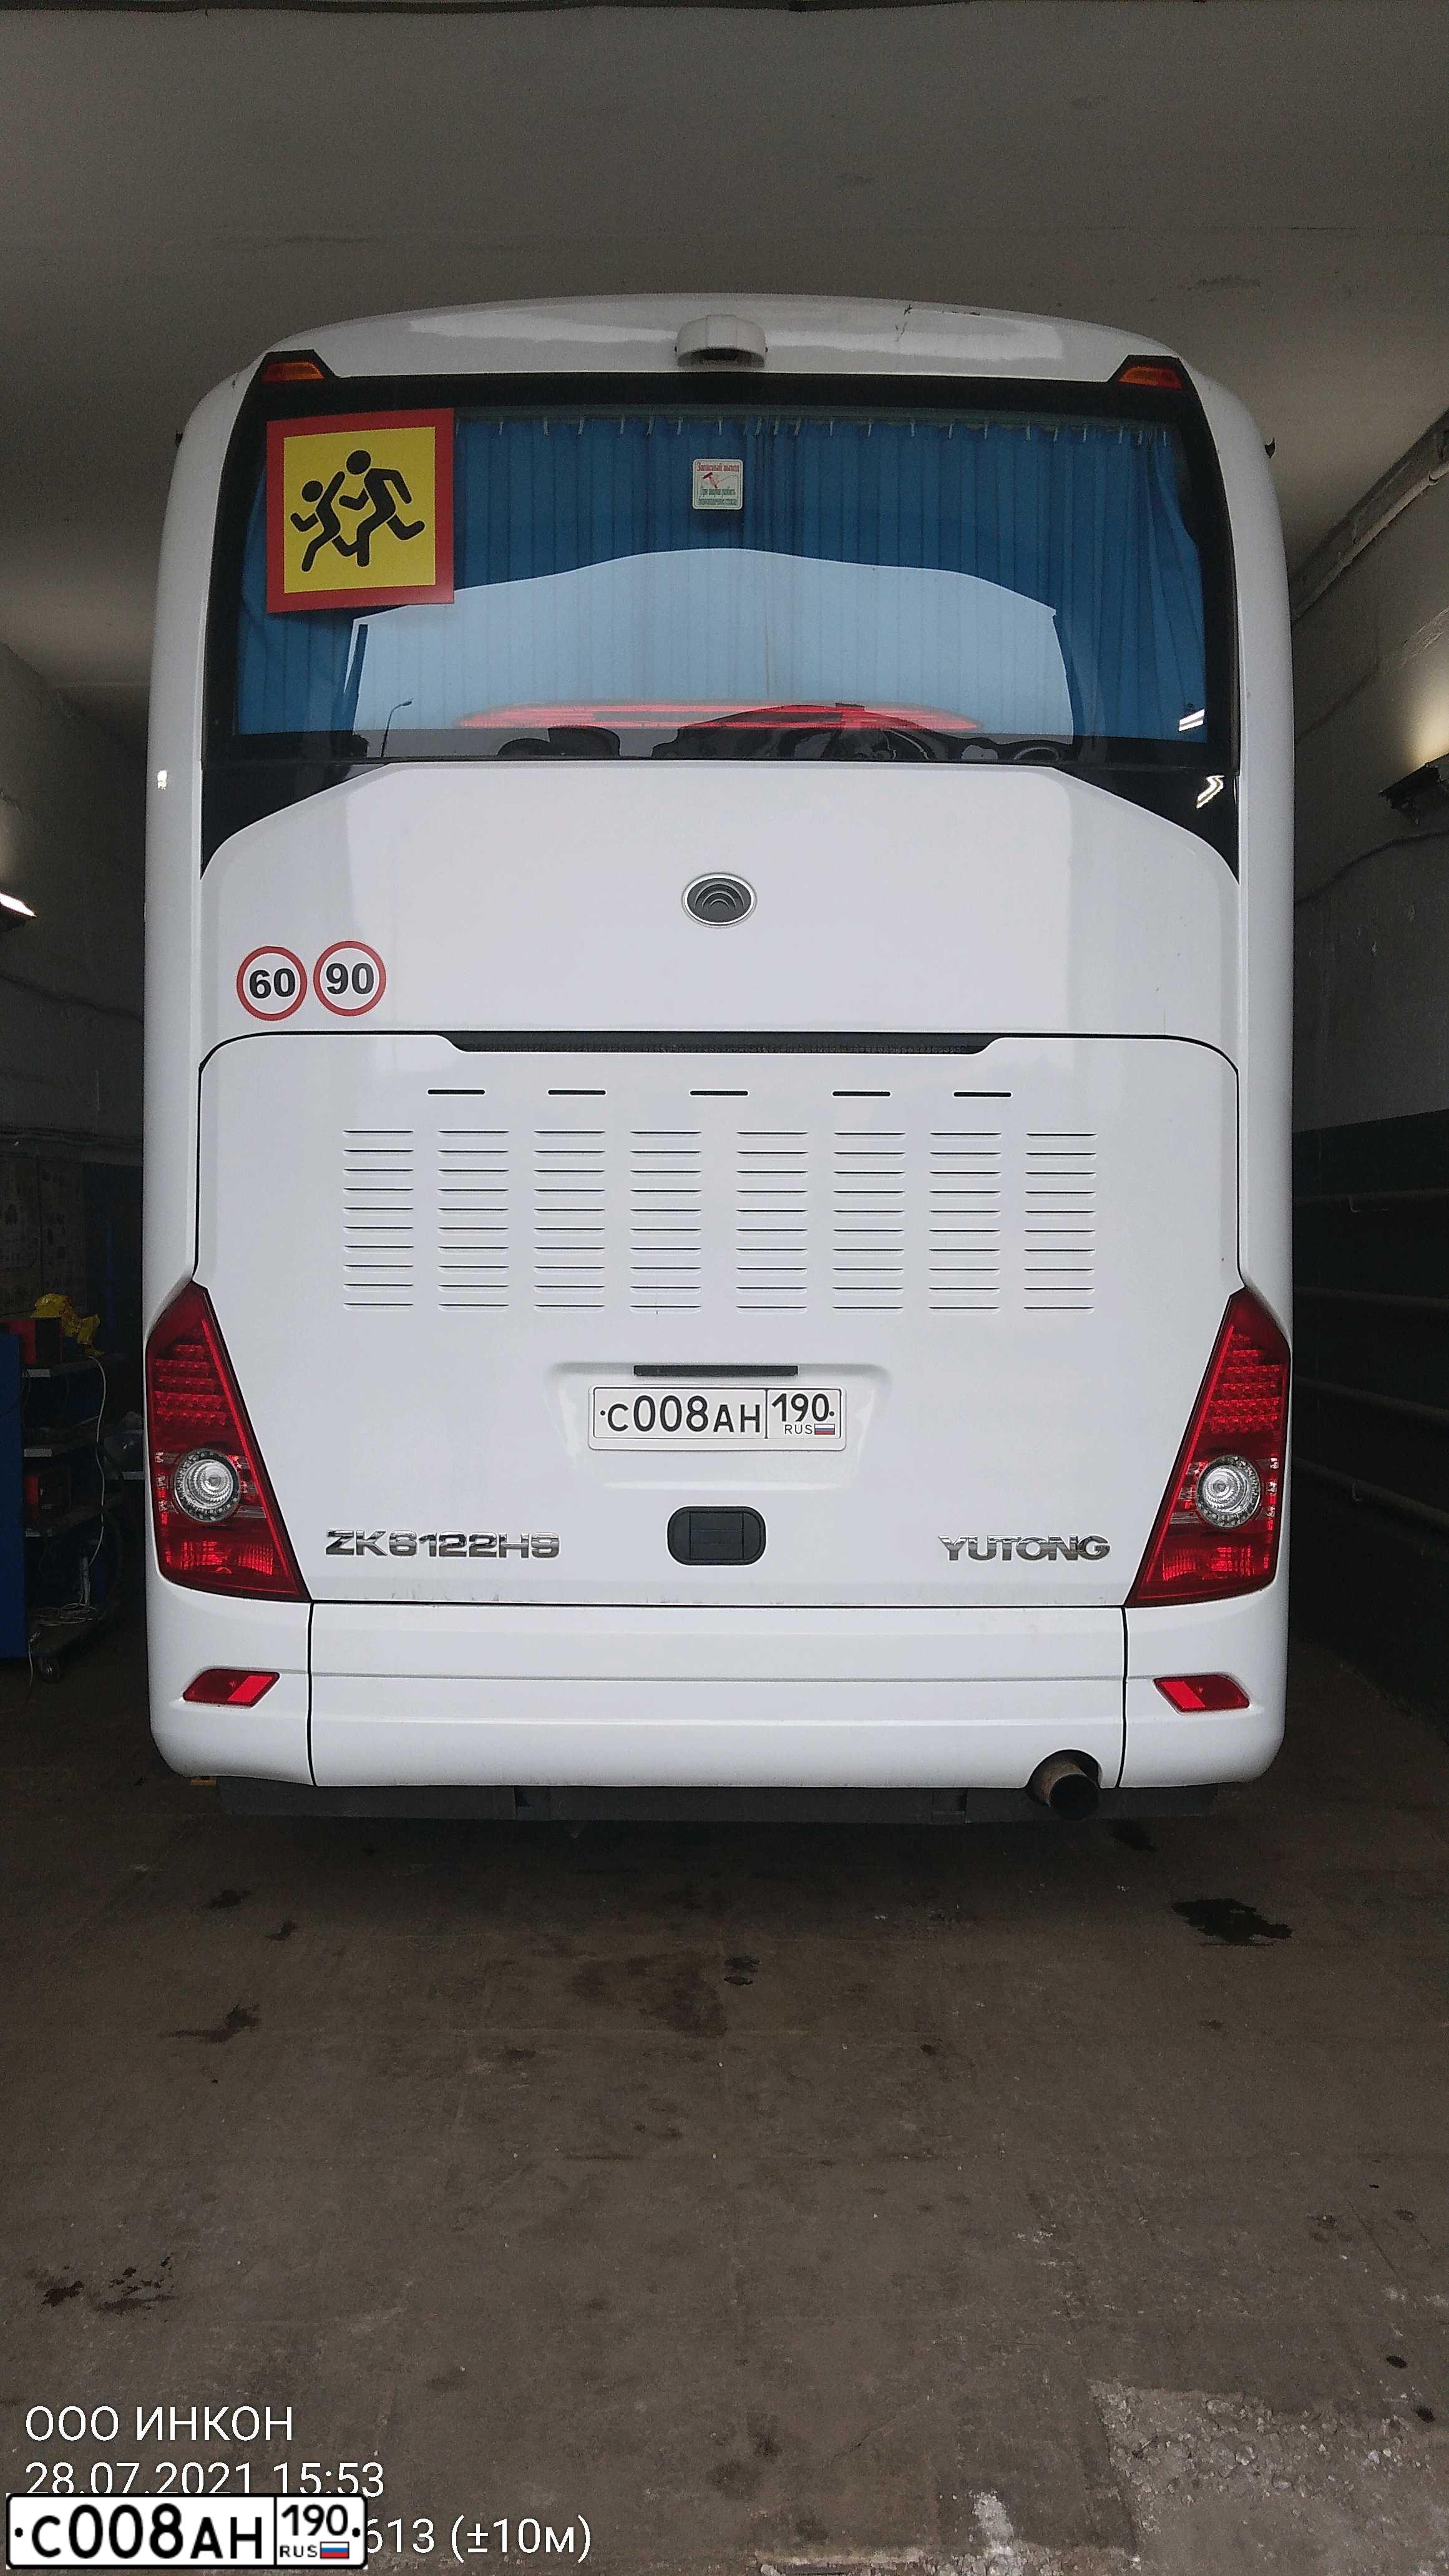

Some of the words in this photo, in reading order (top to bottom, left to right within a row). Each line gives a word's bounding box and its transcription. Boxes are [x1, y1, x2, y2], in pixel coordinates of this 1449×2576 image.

[250, 968, 296, 999] 60
[326, 962, 374, 995] 90
[771, 1393, 829, 1422] 190
[784, 1423, 812, 1435] RUS
[938, 1535, 1111, 1561] YUTONG
